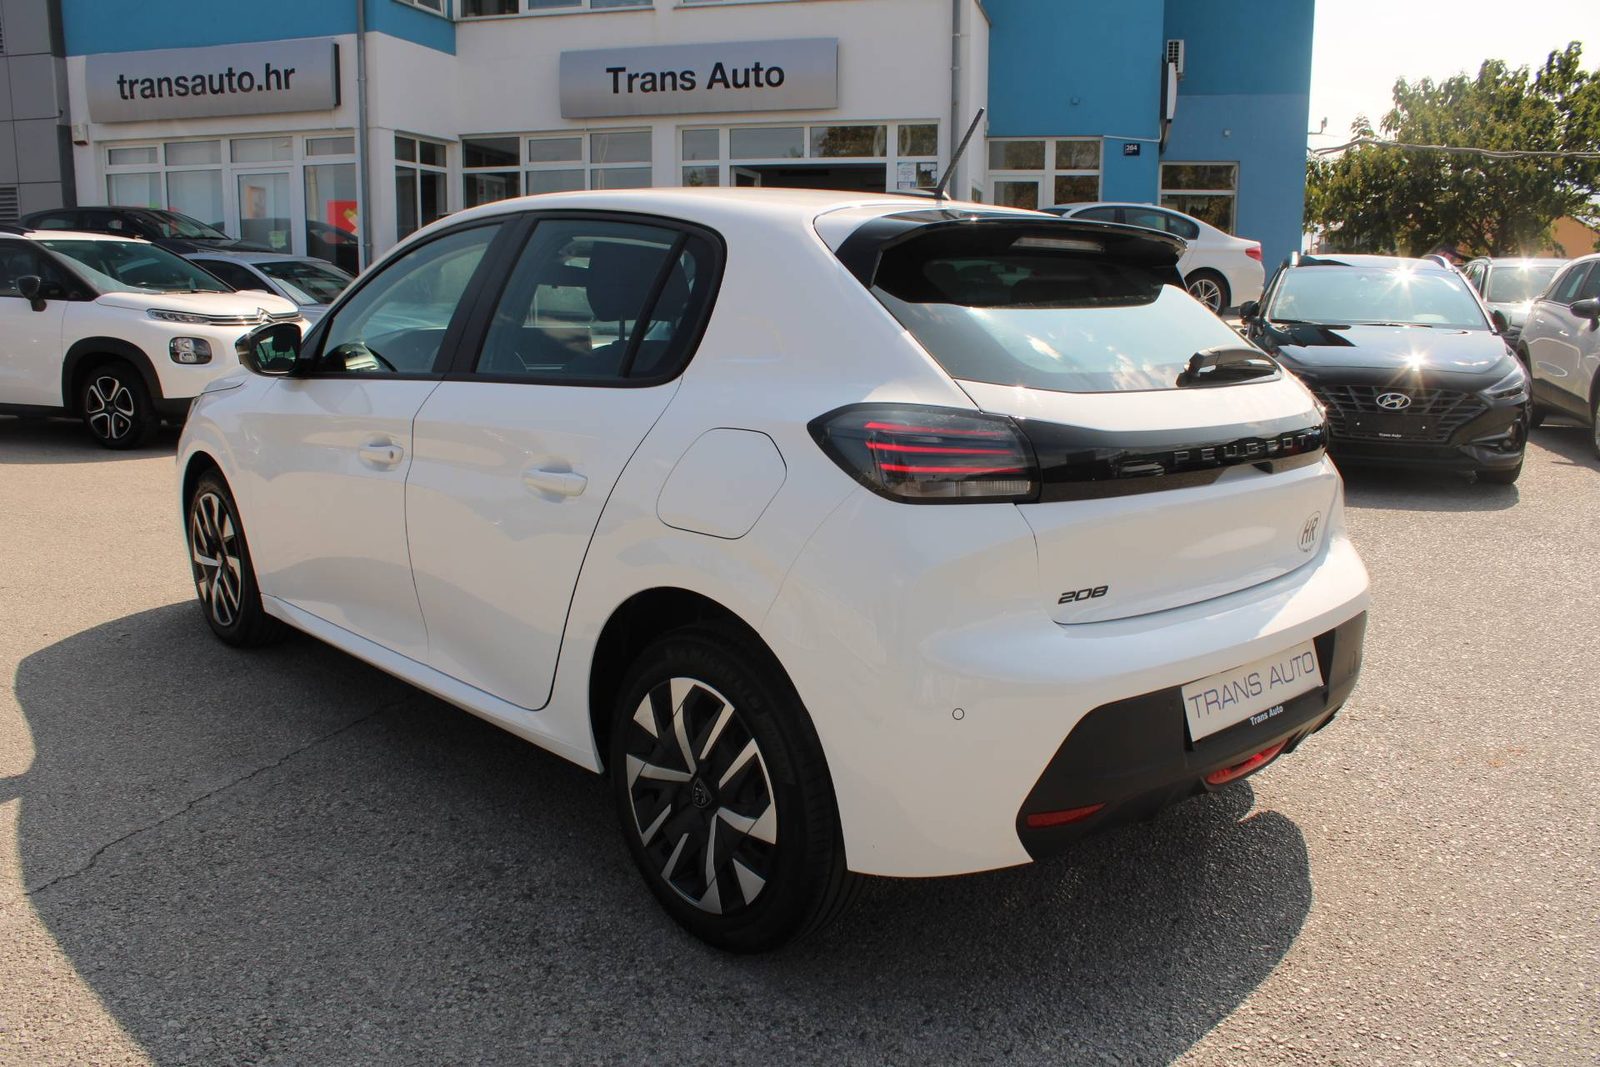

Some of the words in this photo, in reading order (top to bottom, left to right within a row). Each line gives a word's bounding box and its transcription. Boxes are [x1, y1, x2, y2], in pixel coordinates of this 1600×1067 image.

[116, 62, 296, 101] transauto.hr
[605, 66, 697, 94] Trans
[706, 61, 785, 90] Auto
[1174, 435, 1308, 468] PEUGEOT
[1300, 516, 1319, 545] HR
[1058, 585, 1109, 605] 208
[1188, 672, 1263, 718] TRANS
[1269, 651, 1315, 689] AUTO
[1250, 712, 1269, 726] Trans
[1269, 705, 1284, 717] Auto
